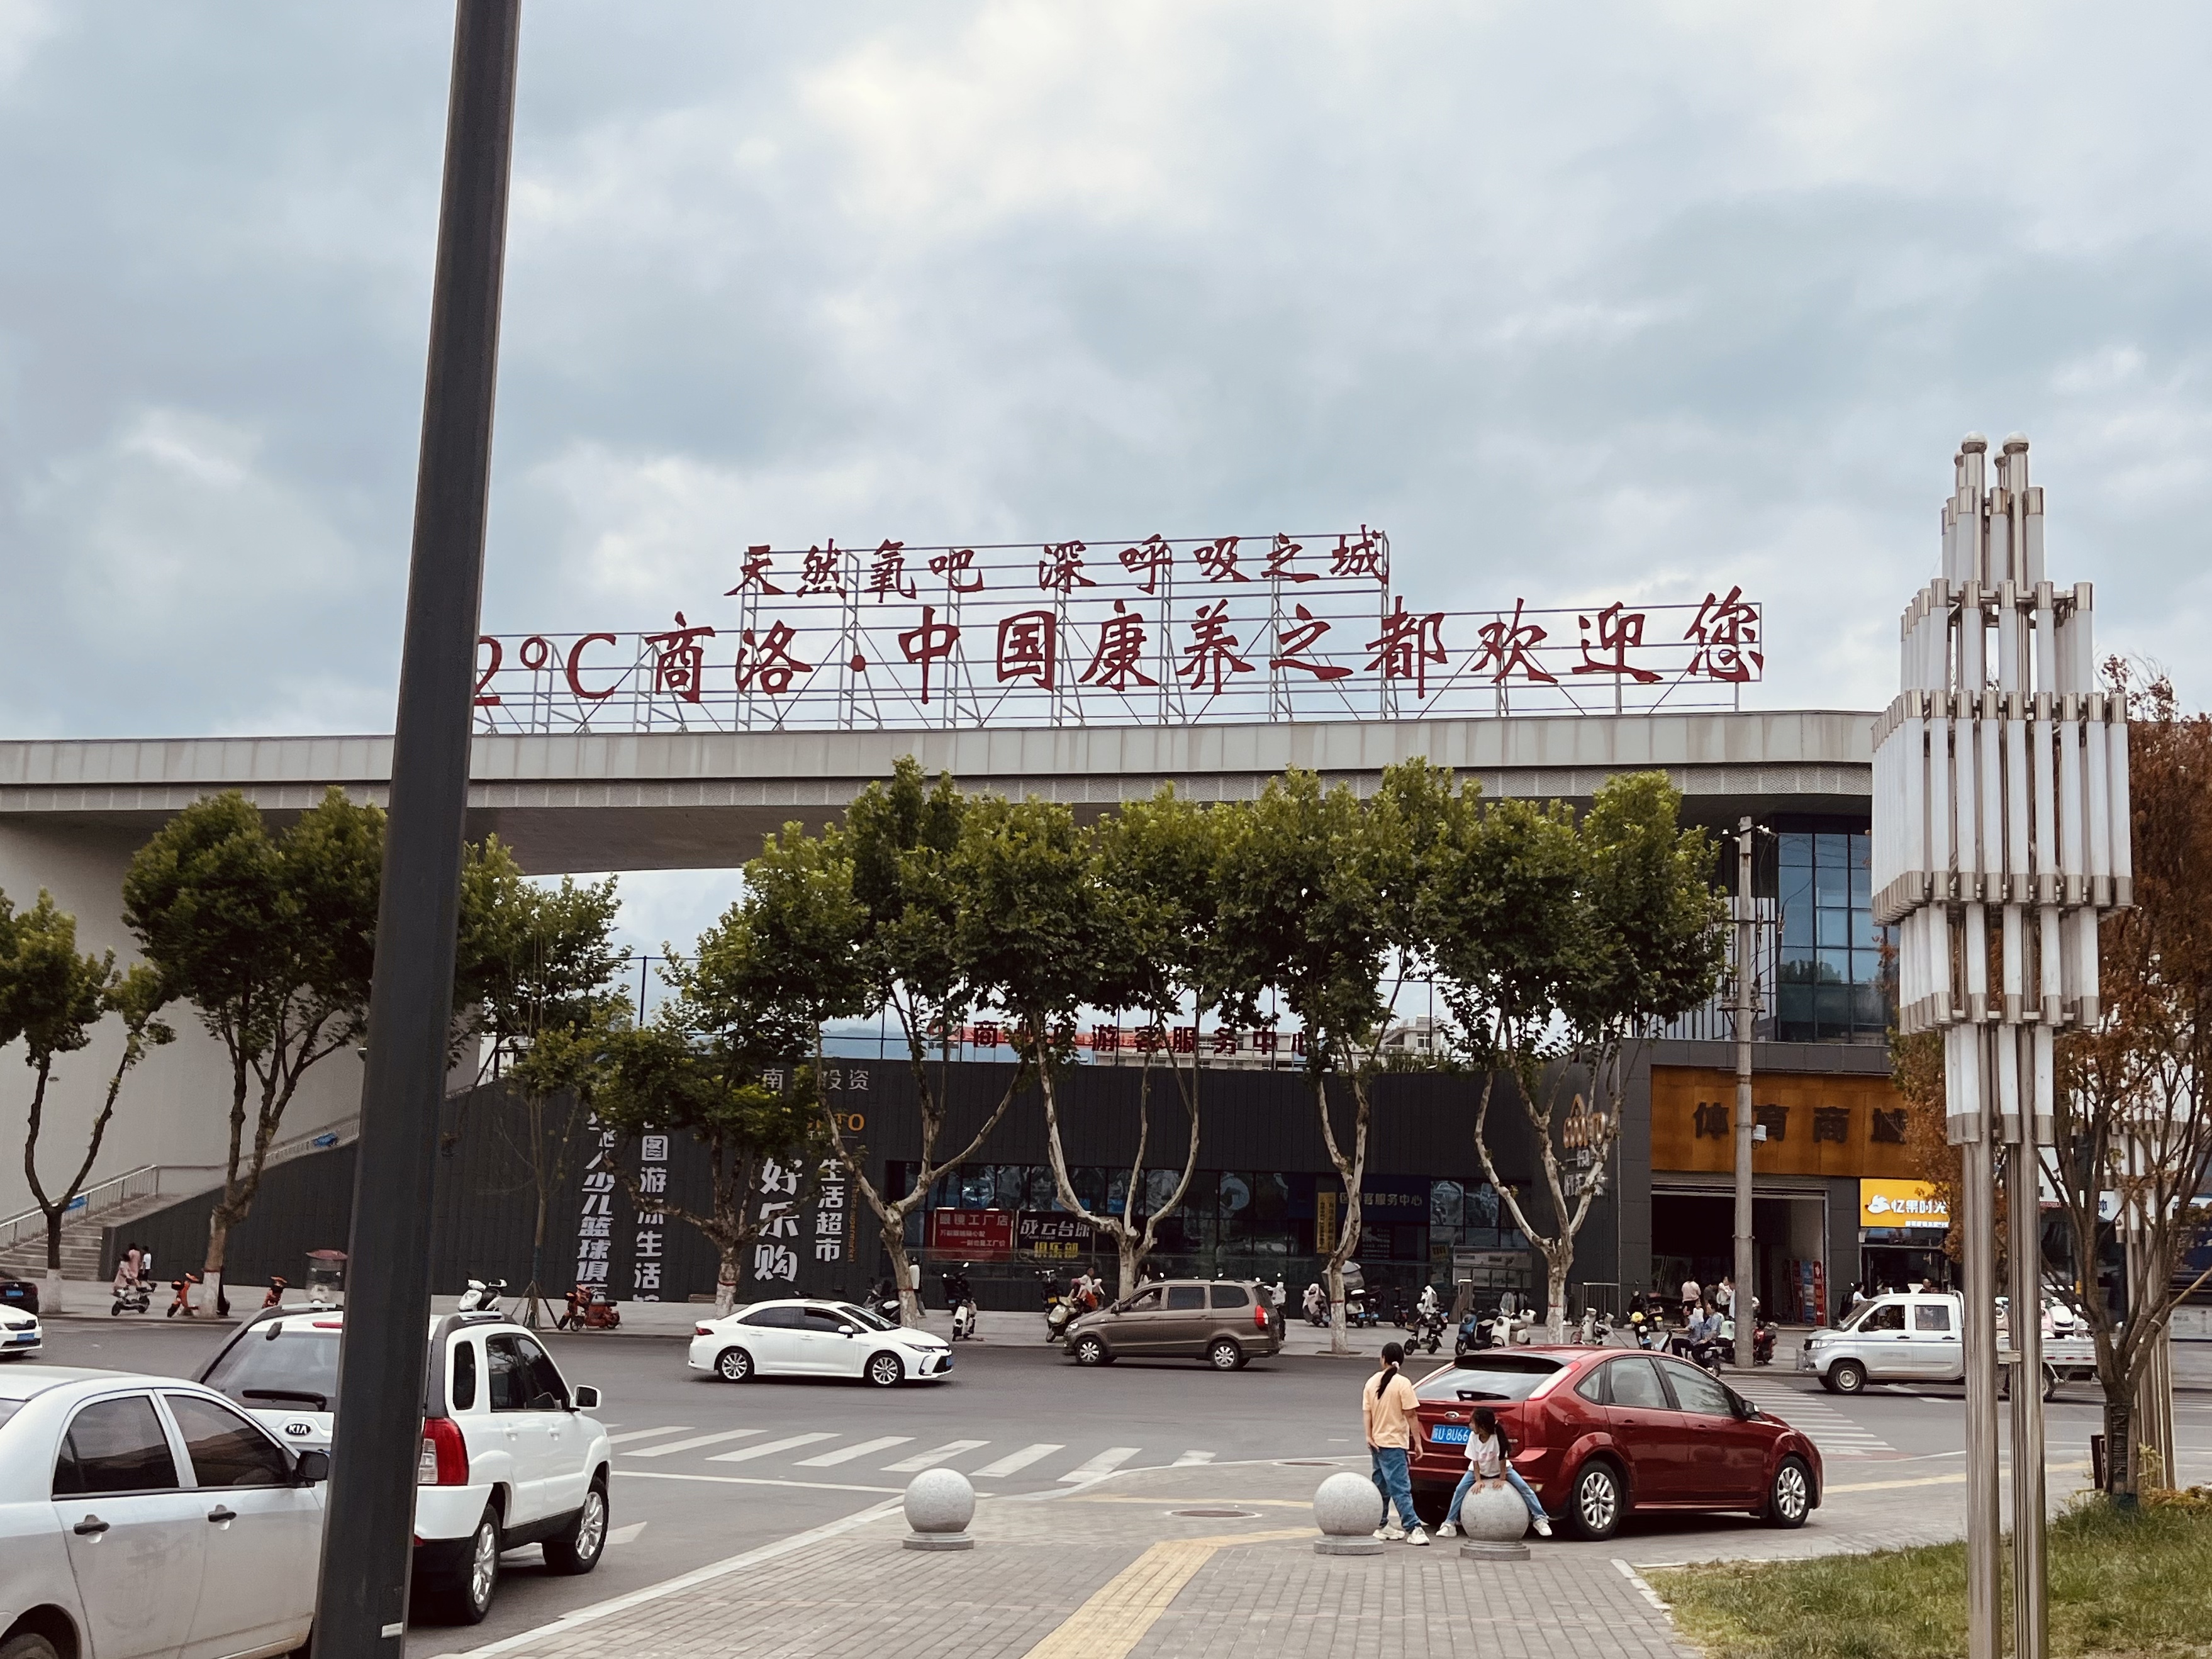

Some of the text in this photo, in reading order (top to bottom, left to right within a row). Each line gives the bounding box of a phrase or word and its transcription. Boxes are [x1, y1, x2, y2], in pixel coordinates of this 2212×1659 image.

[724, 524, 1390, 603] 天然氧吧 深呼吸之城
[754, 1157, 802, 1282] 好乐购
[816, 1159, 845, 1262] 生活超市
[289, 1425, 307, 1434] KIA
